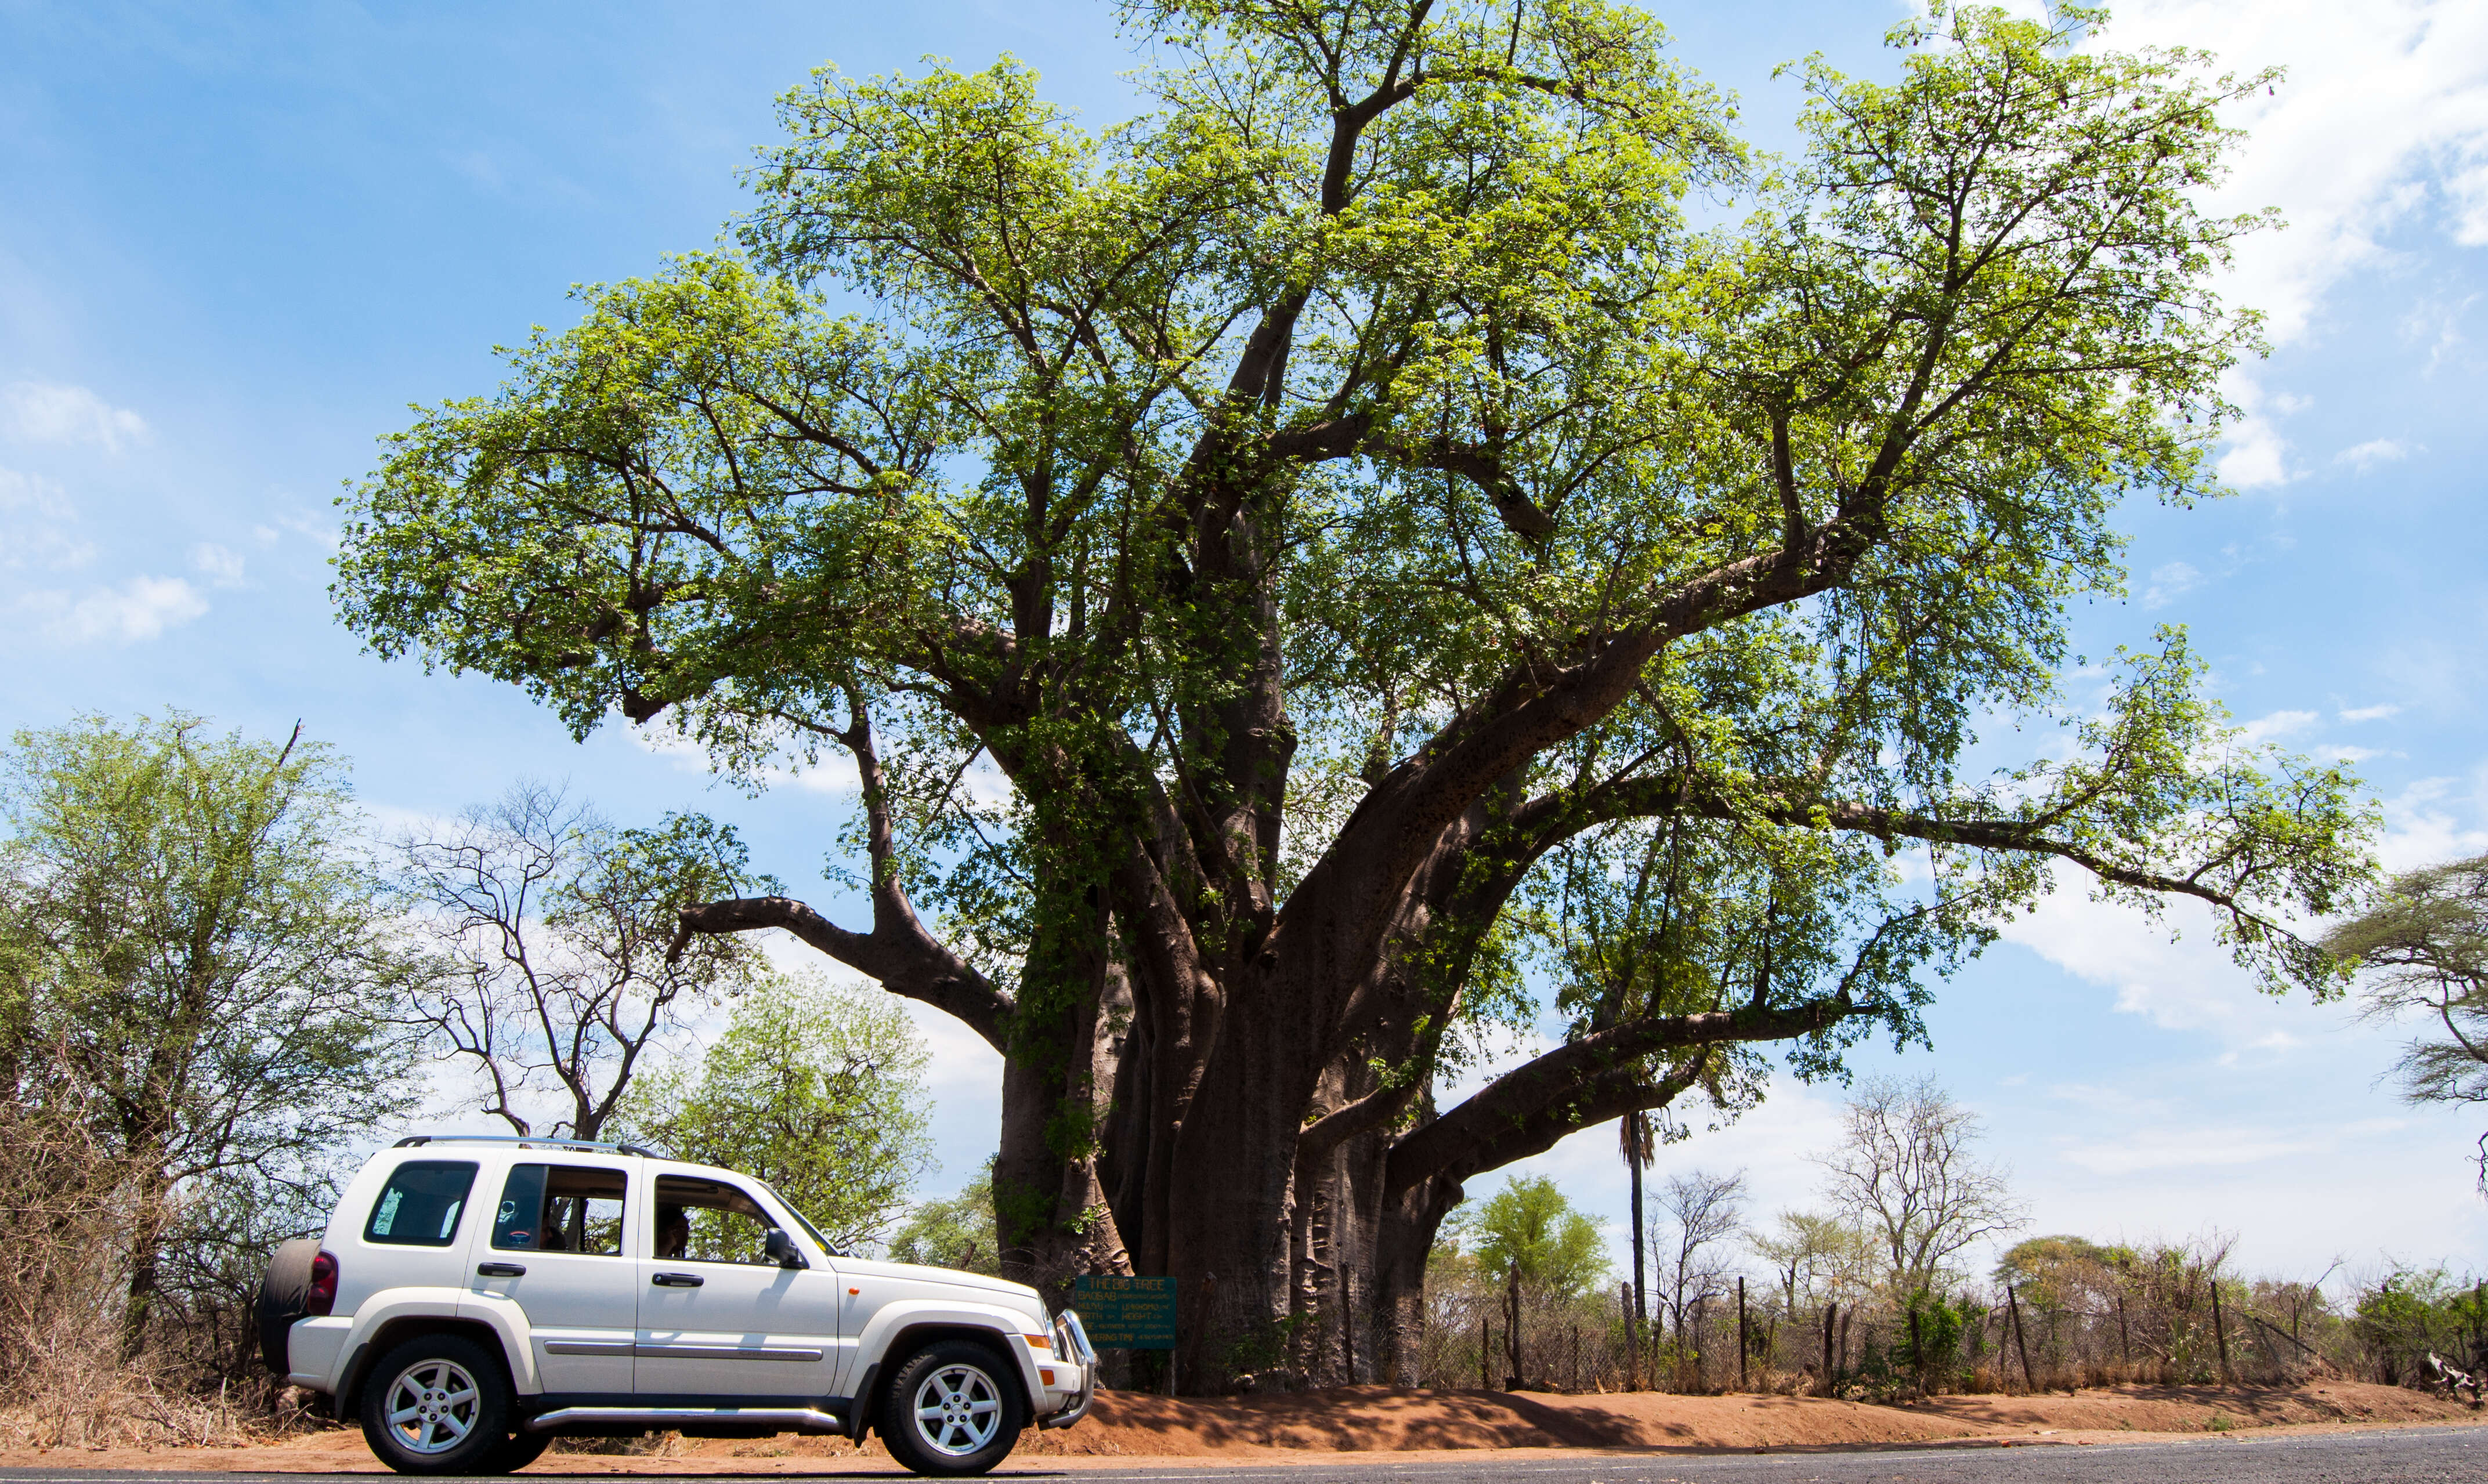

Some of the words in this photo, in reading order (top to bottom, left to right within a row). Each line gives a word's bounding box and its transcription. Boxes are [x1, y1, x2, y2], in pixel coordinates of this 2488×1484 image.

[1089, 1277, 1111, 1290] THE
[1113, 1279, 1130, 1290] BIG
[1133, 1279, 1165, 1291] TREE
[1077, 1290, 1116, 1301] BAOBAB
[1122, 1312, 1152, 1320] HEIGHT
